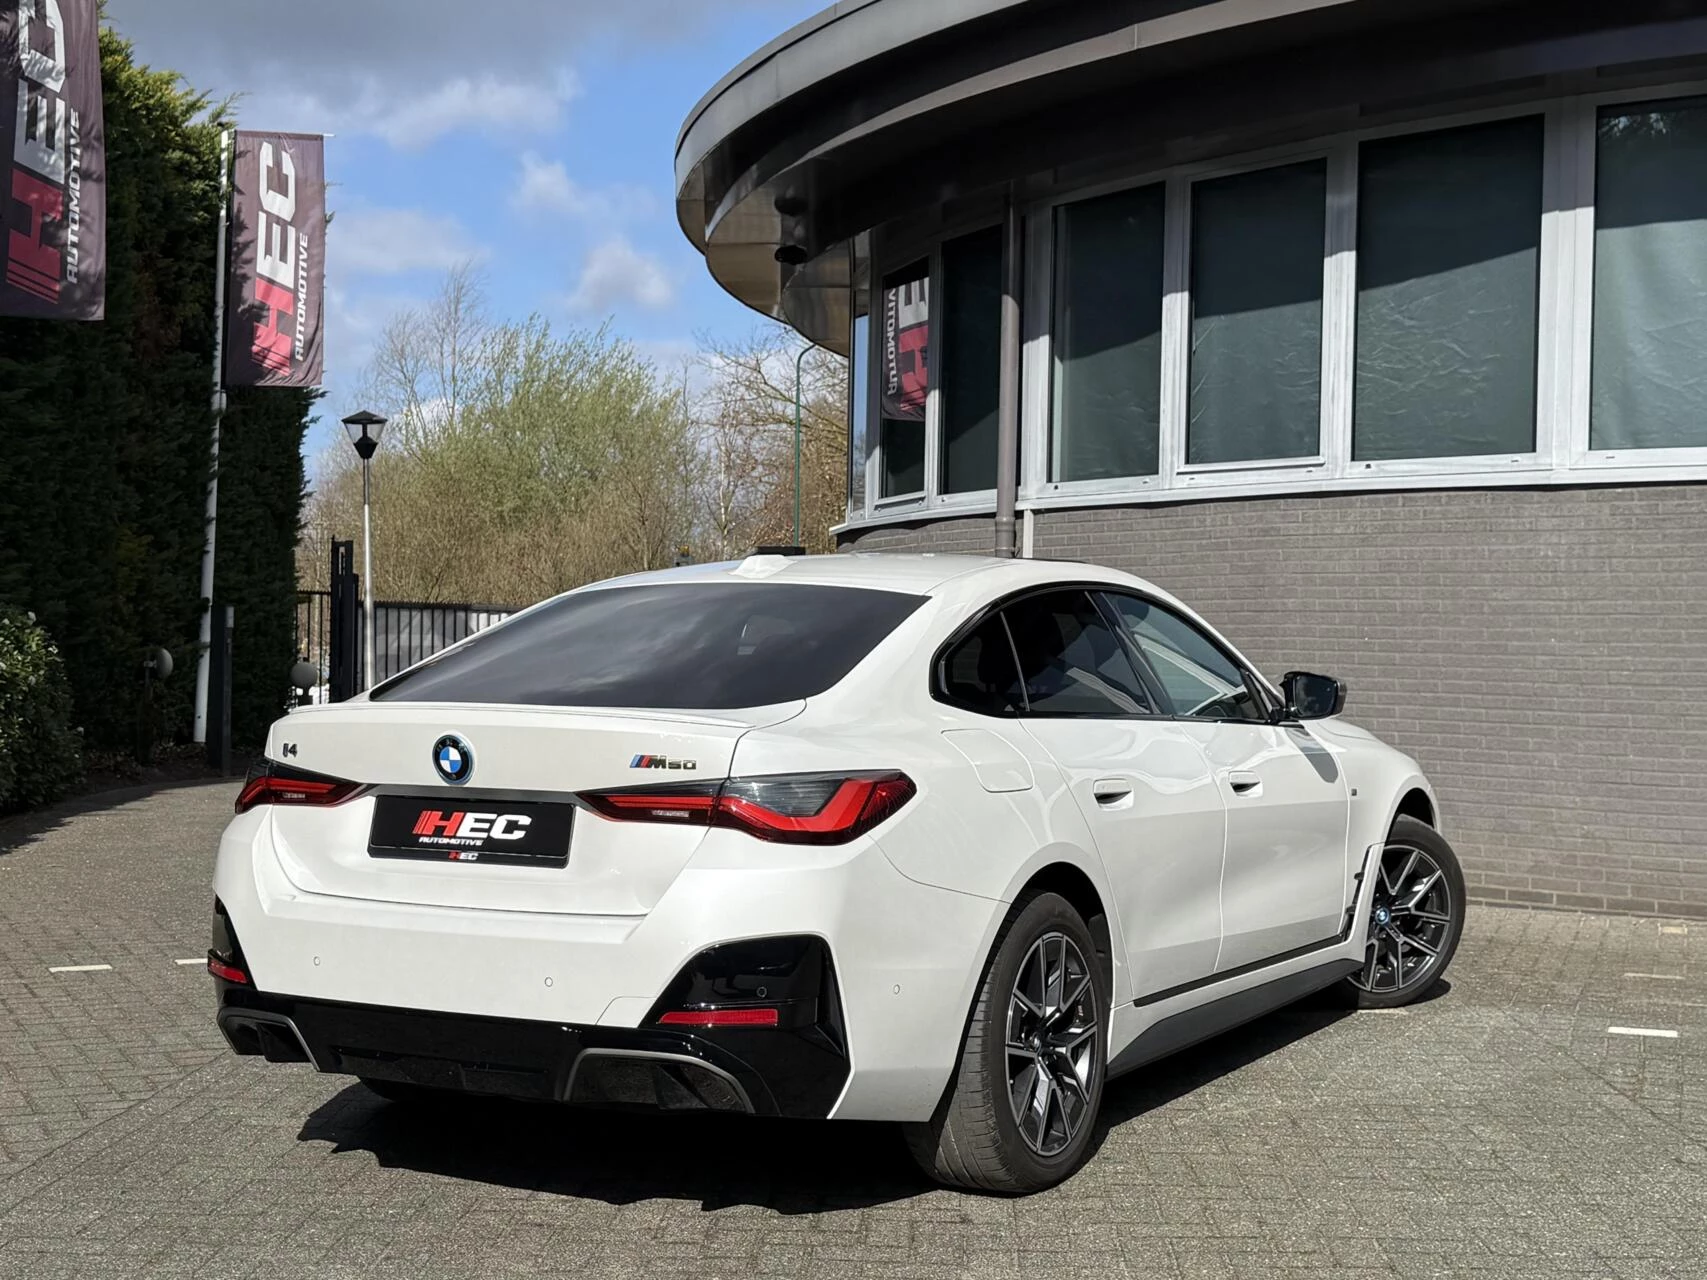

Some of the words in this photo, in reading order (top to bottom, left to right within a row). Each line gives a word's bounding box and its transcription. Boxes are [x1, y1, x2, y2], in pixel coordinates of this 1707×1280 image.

[6, 0, 65, 304] HEC
[66, 107, 81, 284] AUTOMOTIVE
[251, 141, 295, 376] HEC
[295, 232, 308, 361] AUTOMOTIVE
[412, 810, 532, 840] HEC
[419, 837, 484, 846] AUTOMOTIVE
[448, 851, 479, 861] HEC
